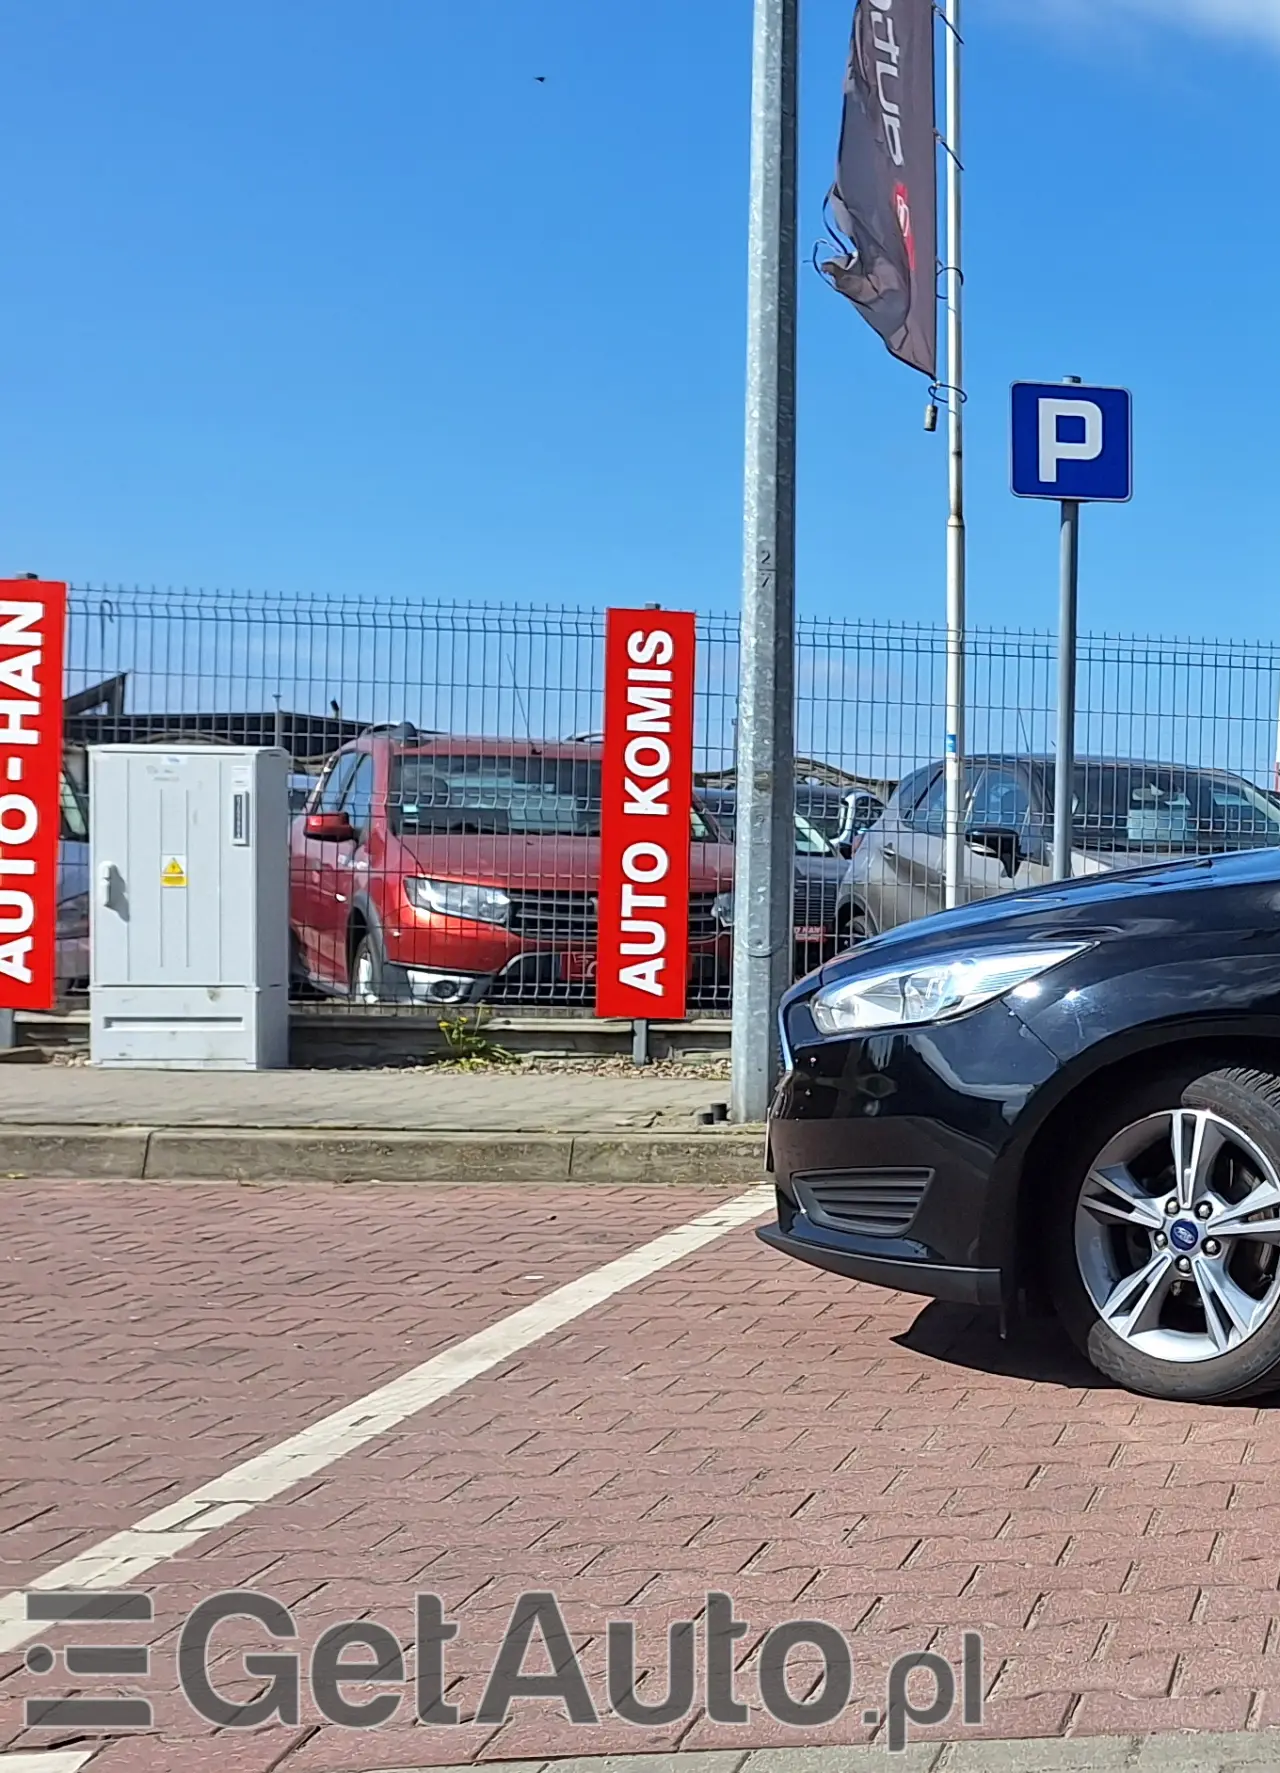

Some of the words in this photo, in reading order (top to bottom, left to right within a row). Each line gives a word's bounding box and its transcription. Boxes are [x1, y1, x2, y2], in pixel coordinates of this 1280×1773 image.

[1038, 397, 1103, 483] P
[623, 630, 673, 816] KOMIS
[618, 842, 669, 997] AUTO
